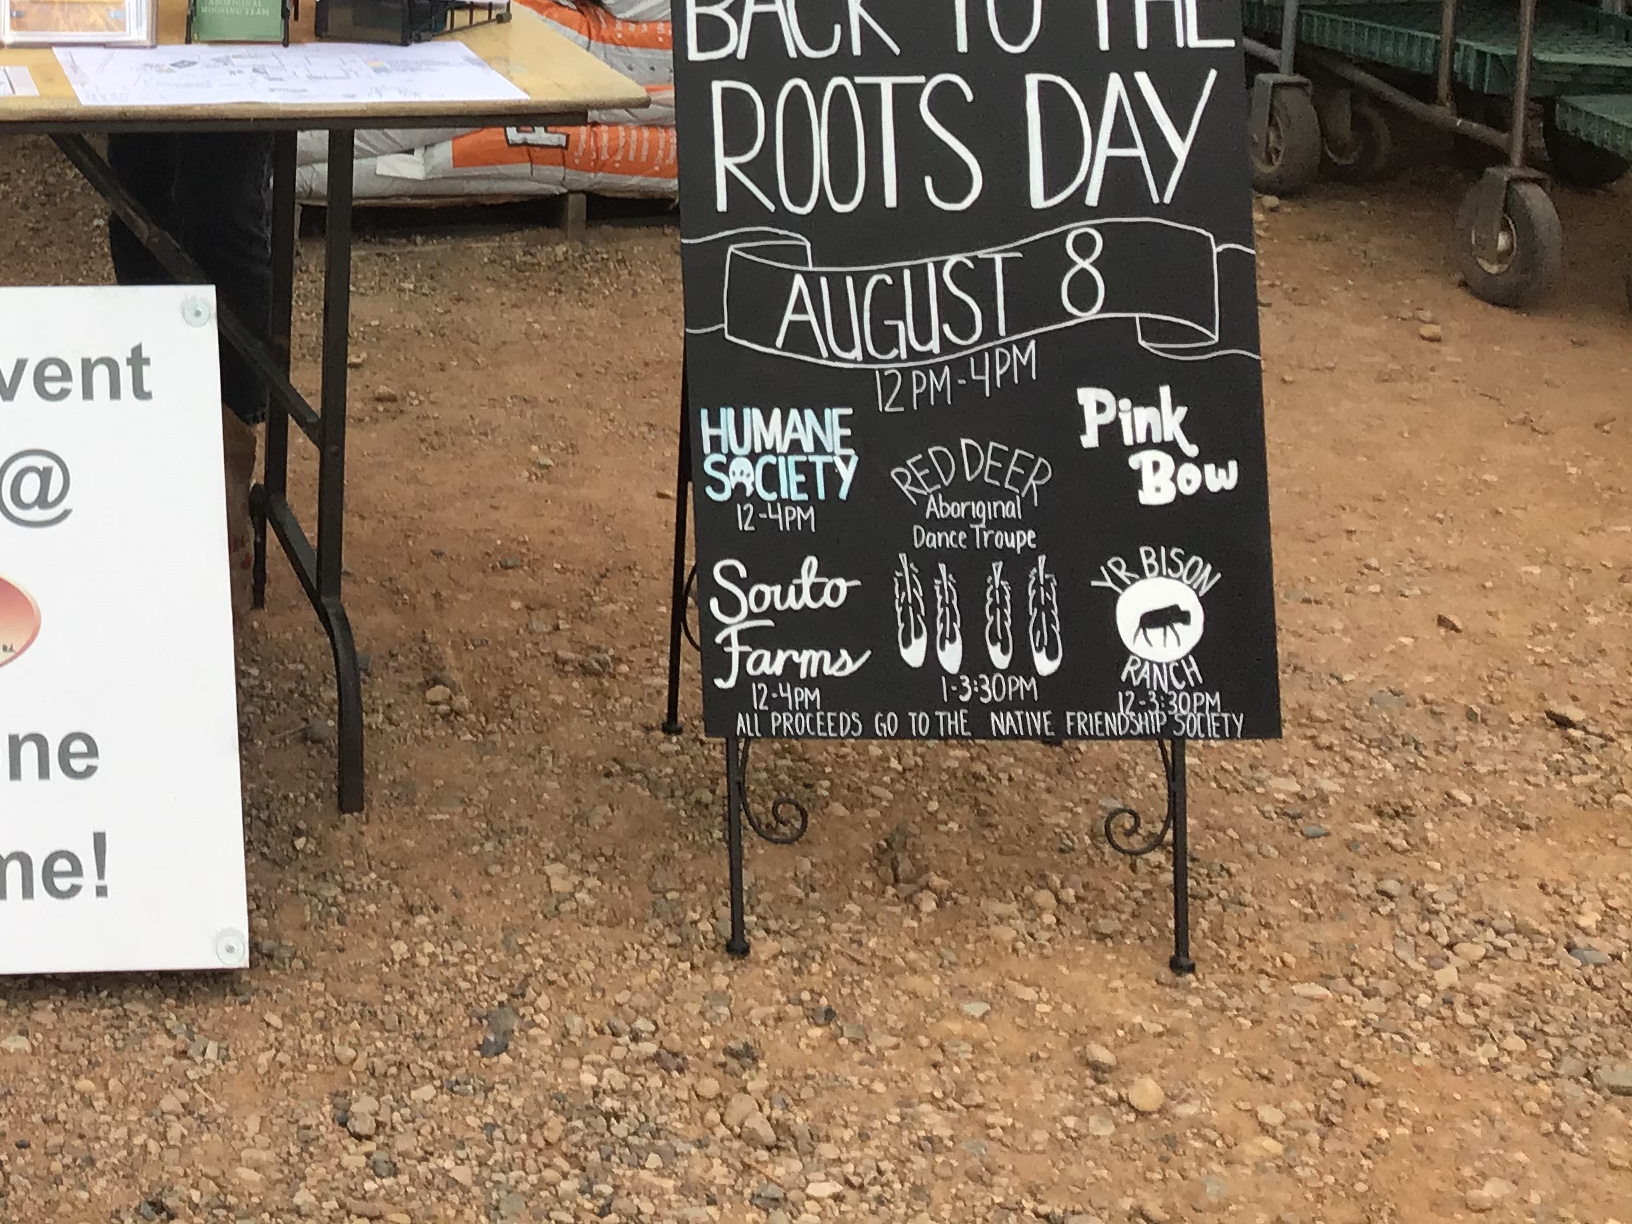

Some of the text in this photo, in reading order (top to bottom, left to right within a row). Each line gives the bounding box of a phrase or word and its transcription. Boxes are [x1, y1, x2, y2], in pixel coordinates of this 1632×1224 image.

[711, 69, 1218, 216] ROOTS DAY
[775, 227, 1106, 361] AUGUST 8
[700, 407, 855, 456] HUMANE
[1076, 385, 1200, 458] Pink
[703, 454, 859, 502] SOCIETY
[890, 437, 1053, 507] RED DEER
[1128, 449, 1239, 506] Bow
[737, 503, 816, 533] 12-4PM
[925, 494, 1022, 527] Aboriginal
[913, 524, 1037, 555] Dance Troupe
[710, 555, 862, 625] Souto
[1090, 545, 1222, 597] YR BISON
[713, 619, 872, 690] Farms
[1120, 654, 1204, 694] RANCH
[751, 681, 821, 711] 12-4PM
[941, 675, 1039, 703] 1-3:30PM
[736, 709, 1244, 738] ALL PROCEEDS GO TO THE NATIVE FRIENDSHIP SOCIETY
